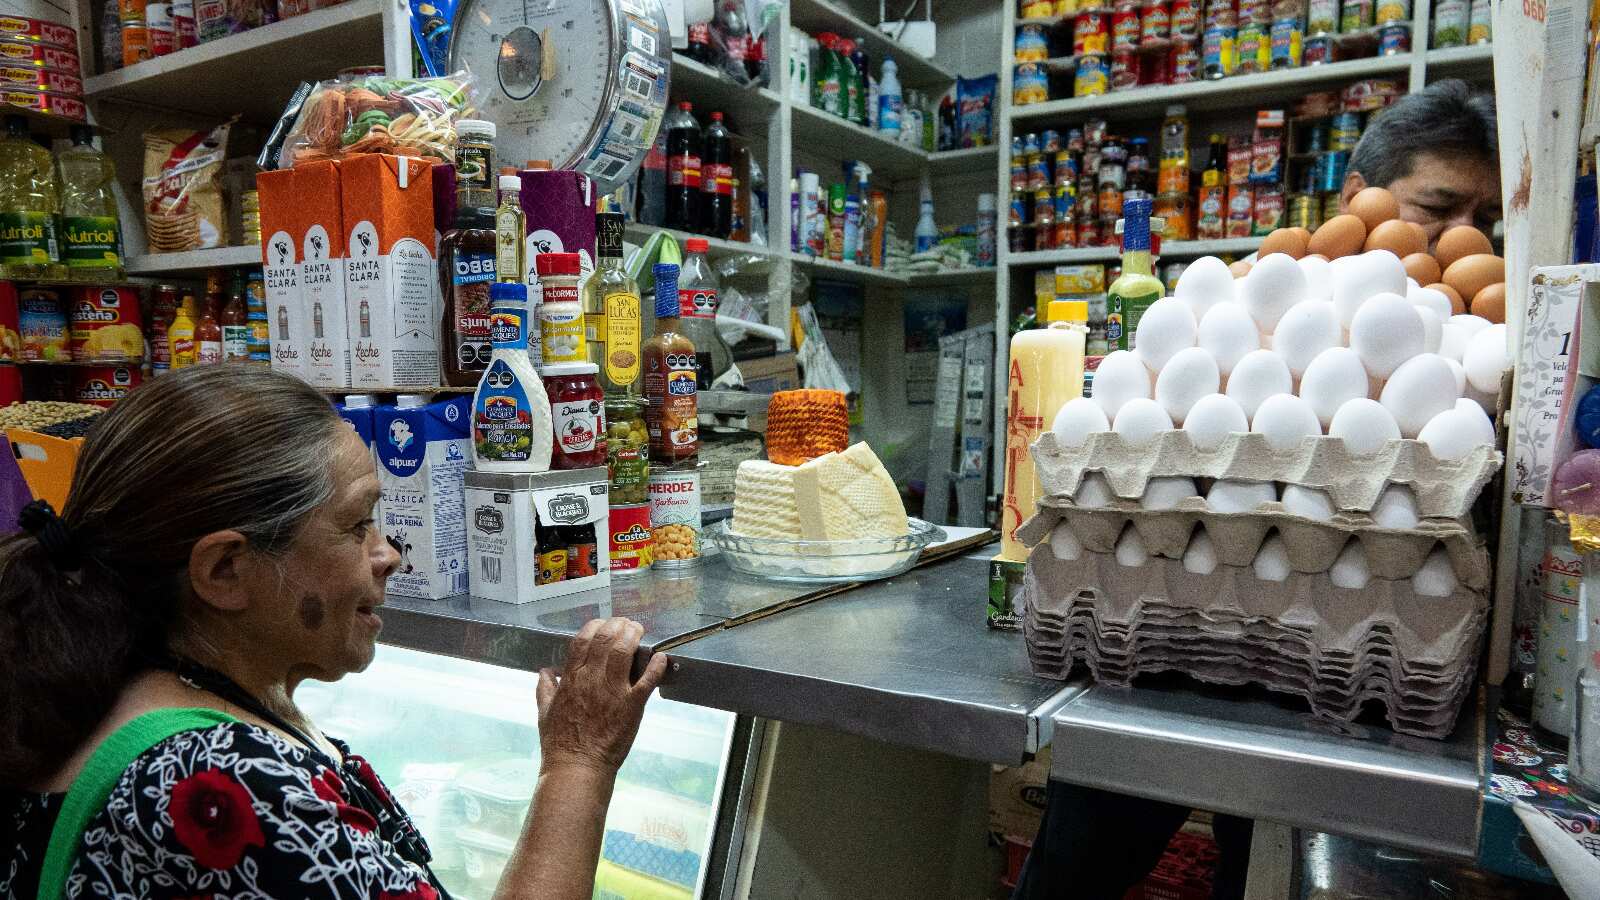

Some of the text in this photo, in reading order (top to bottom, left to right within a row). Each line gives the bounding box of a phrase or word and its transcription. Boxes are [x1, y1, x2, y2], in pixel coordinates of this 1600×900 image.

[0, 225, 43, 239] utrioli
[64, 229, 115, 243] Nutrioli
[304, 264, 331, 273] SANTA
[350, 261, 380, 271] SANTA
[456, 259, 495, 275] BBQ
[267, 269, 296, 278] SANTA
[304, 273, 332, 284] CLARA
[350, 271, 380, 282] CLARA
[461, 274, 496, 283] ORIGINAL
[268, 279, 297, 288] CLARA
[545, 290, 578, 298] McCORMICK
[617, 298, 630, 306] SAN
[72, 310, 113, 321] osteña
[610, 304, 637, 318] LUCAS
[275, 343, 299, 363] Leche
[310, 341, 333, 361] Leche
[355, 341, 379, 362] Leche
[90, 381, 104, 390] La
[81, 388, 127, 399] osteña
[562, 406, 587, 416] Diana
[488, 430, 518, 443] Ranch
[389, 457, 416, 469] alpura
[647, 481, 694, 494] HERDEZ
[382, 492, 424, 504] CLÁSICA
[405, 519, 423, 527] REINA
